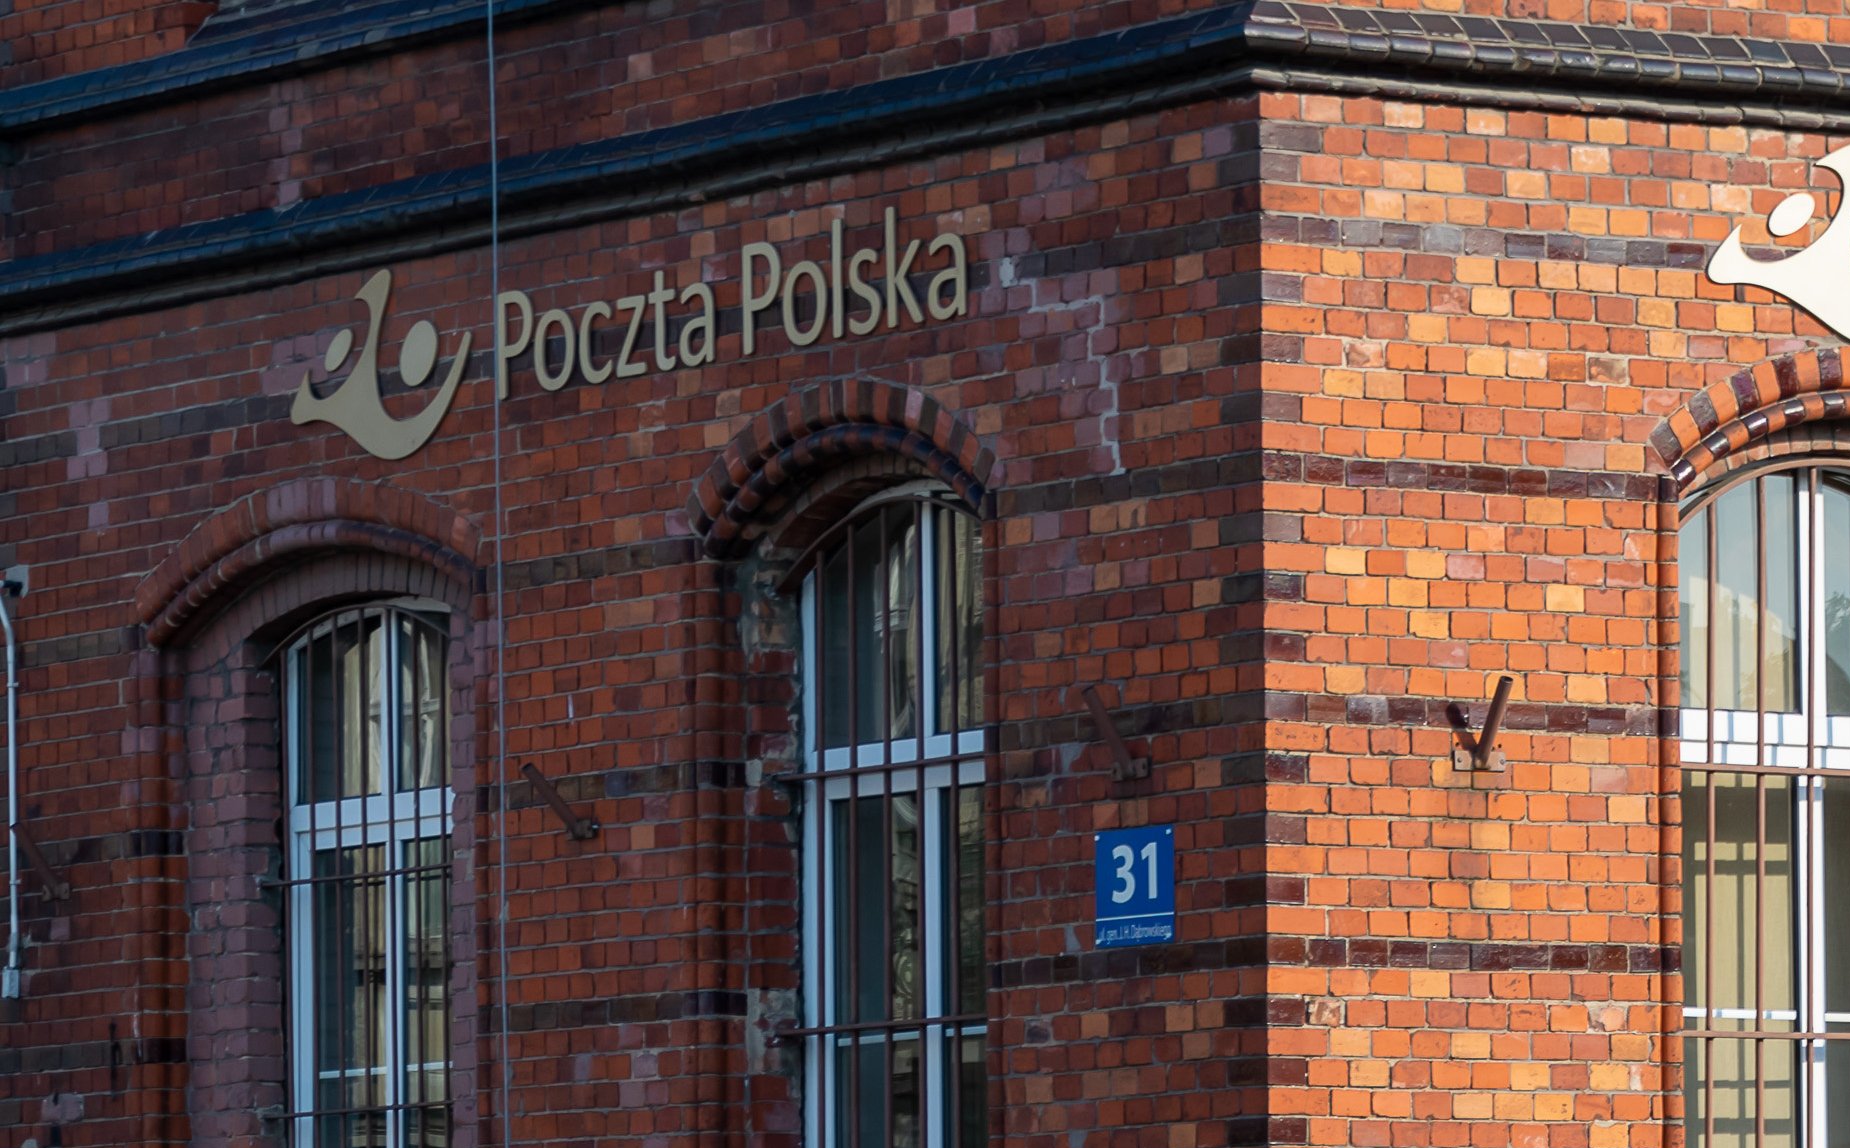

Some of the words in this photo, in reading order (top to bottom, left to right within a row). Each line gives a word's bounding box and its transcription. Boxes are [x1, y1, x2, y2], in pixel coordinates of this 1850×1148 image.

[498, 269, 716, 400] Poczta
[742, 206, 969, 356] Polska
[1111, 842, 1157, 904] 31
